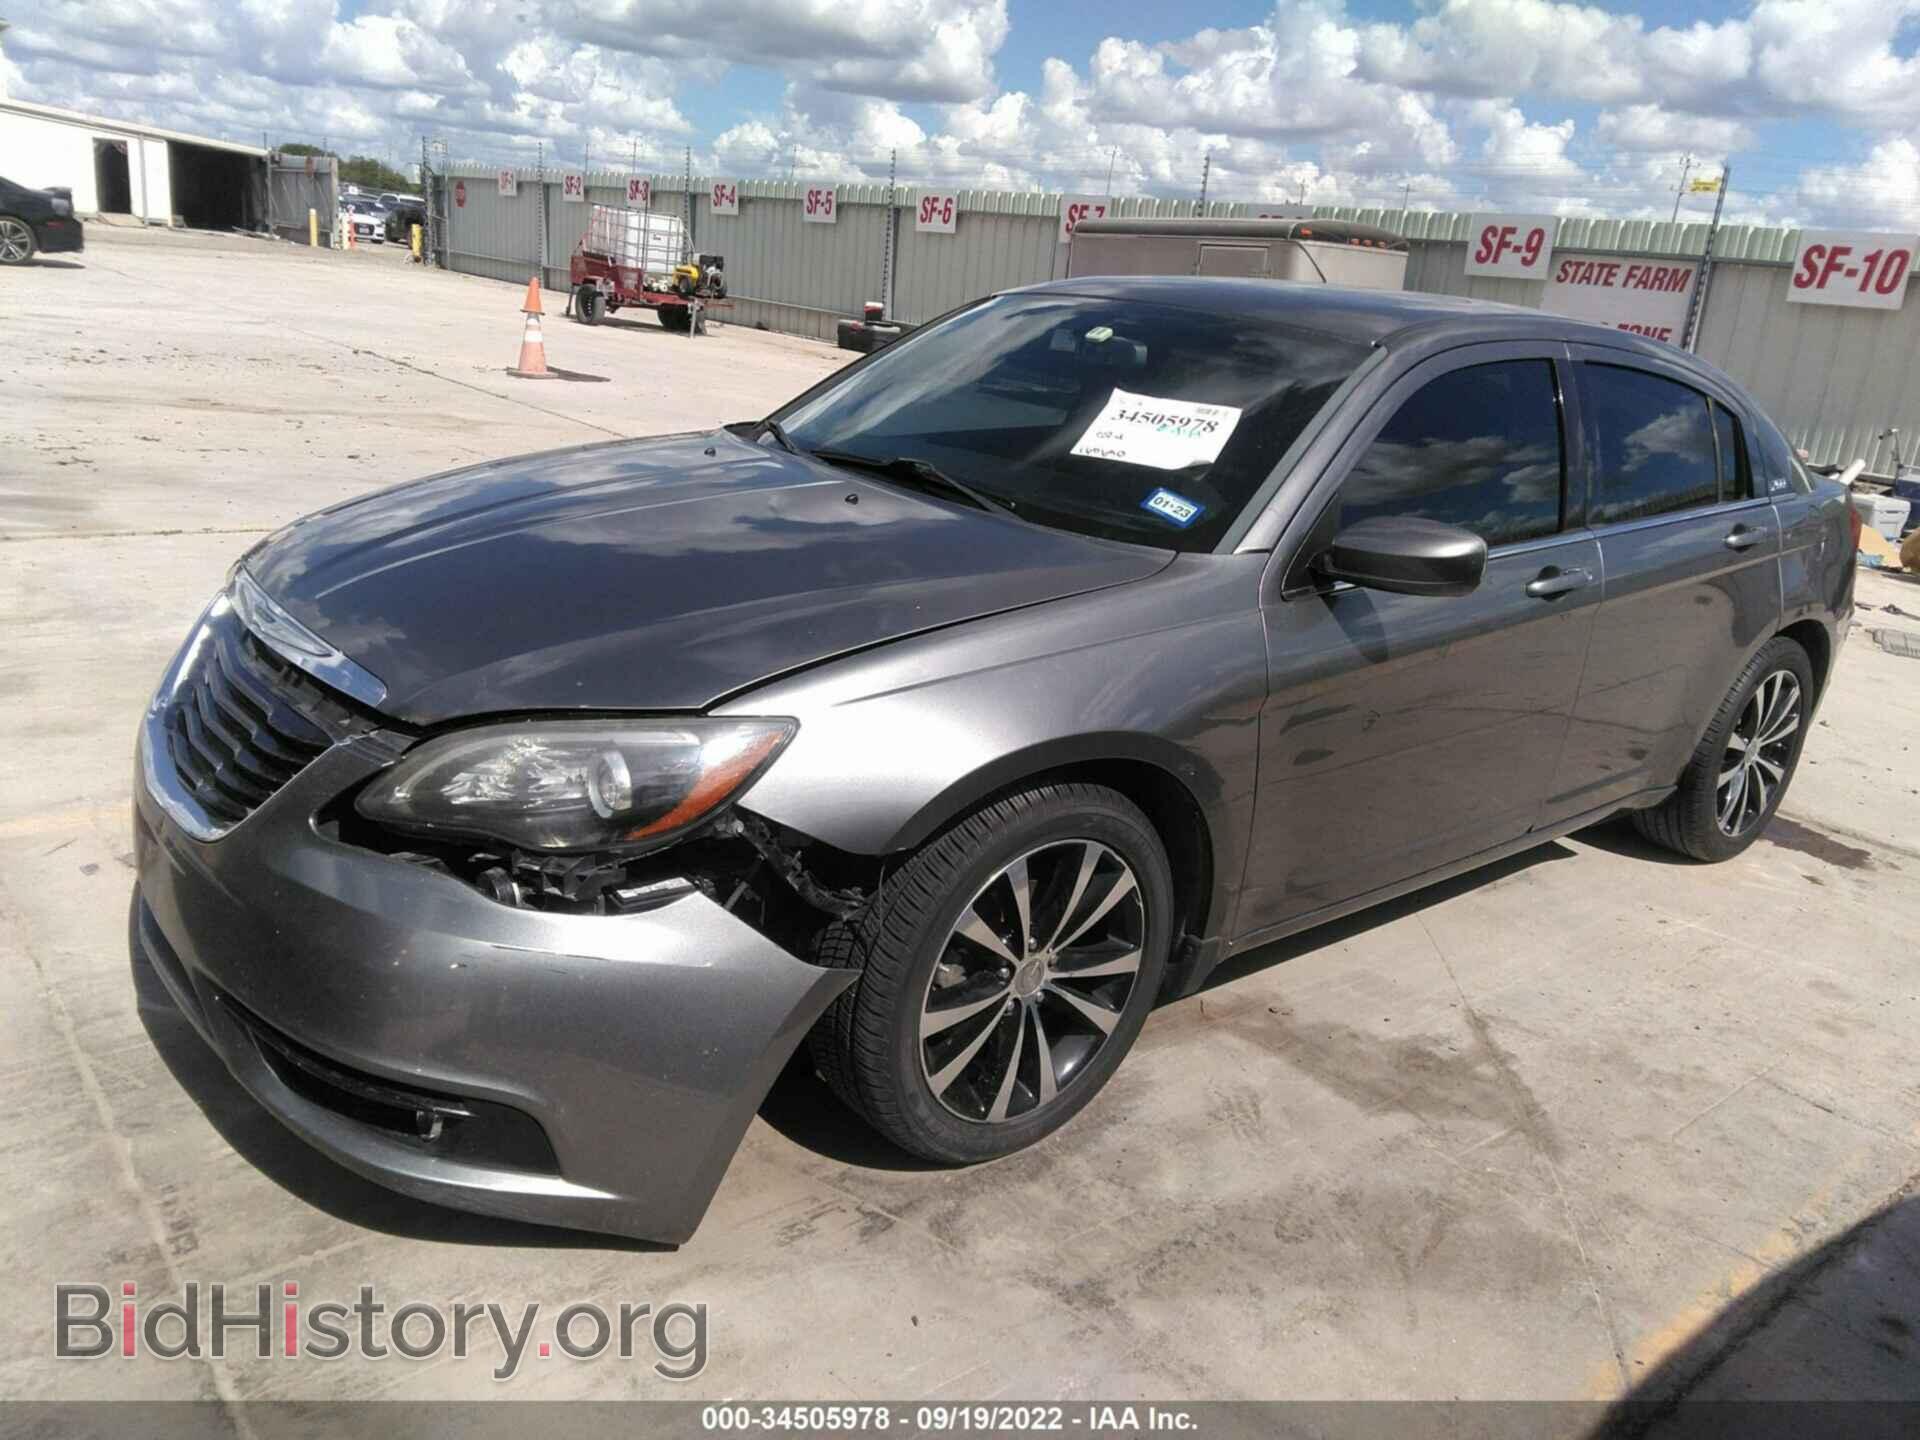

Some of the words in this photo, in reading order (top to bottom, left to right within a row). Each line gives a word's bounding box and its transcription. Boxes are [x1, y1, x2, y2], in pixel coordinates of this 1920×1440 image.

[565, 175, 581, 196] SF-2
[629, 179, 649, 201] SF-3
[713, 184, 736, 208] SF-4
[806, 189, 833, 215] SF-5
[919, 196, 953, 225] SF-6
[1065, 203, 1105, 234] SF7
[1474, 224, 1545, 267] SF-9
[1556, 259, 1621, 287] STATE
[1622, 264, 1693, 293] FARM
[1793, 244, 1910, 295] SF-10
[1112, 409, 1220, 434] 34505978
